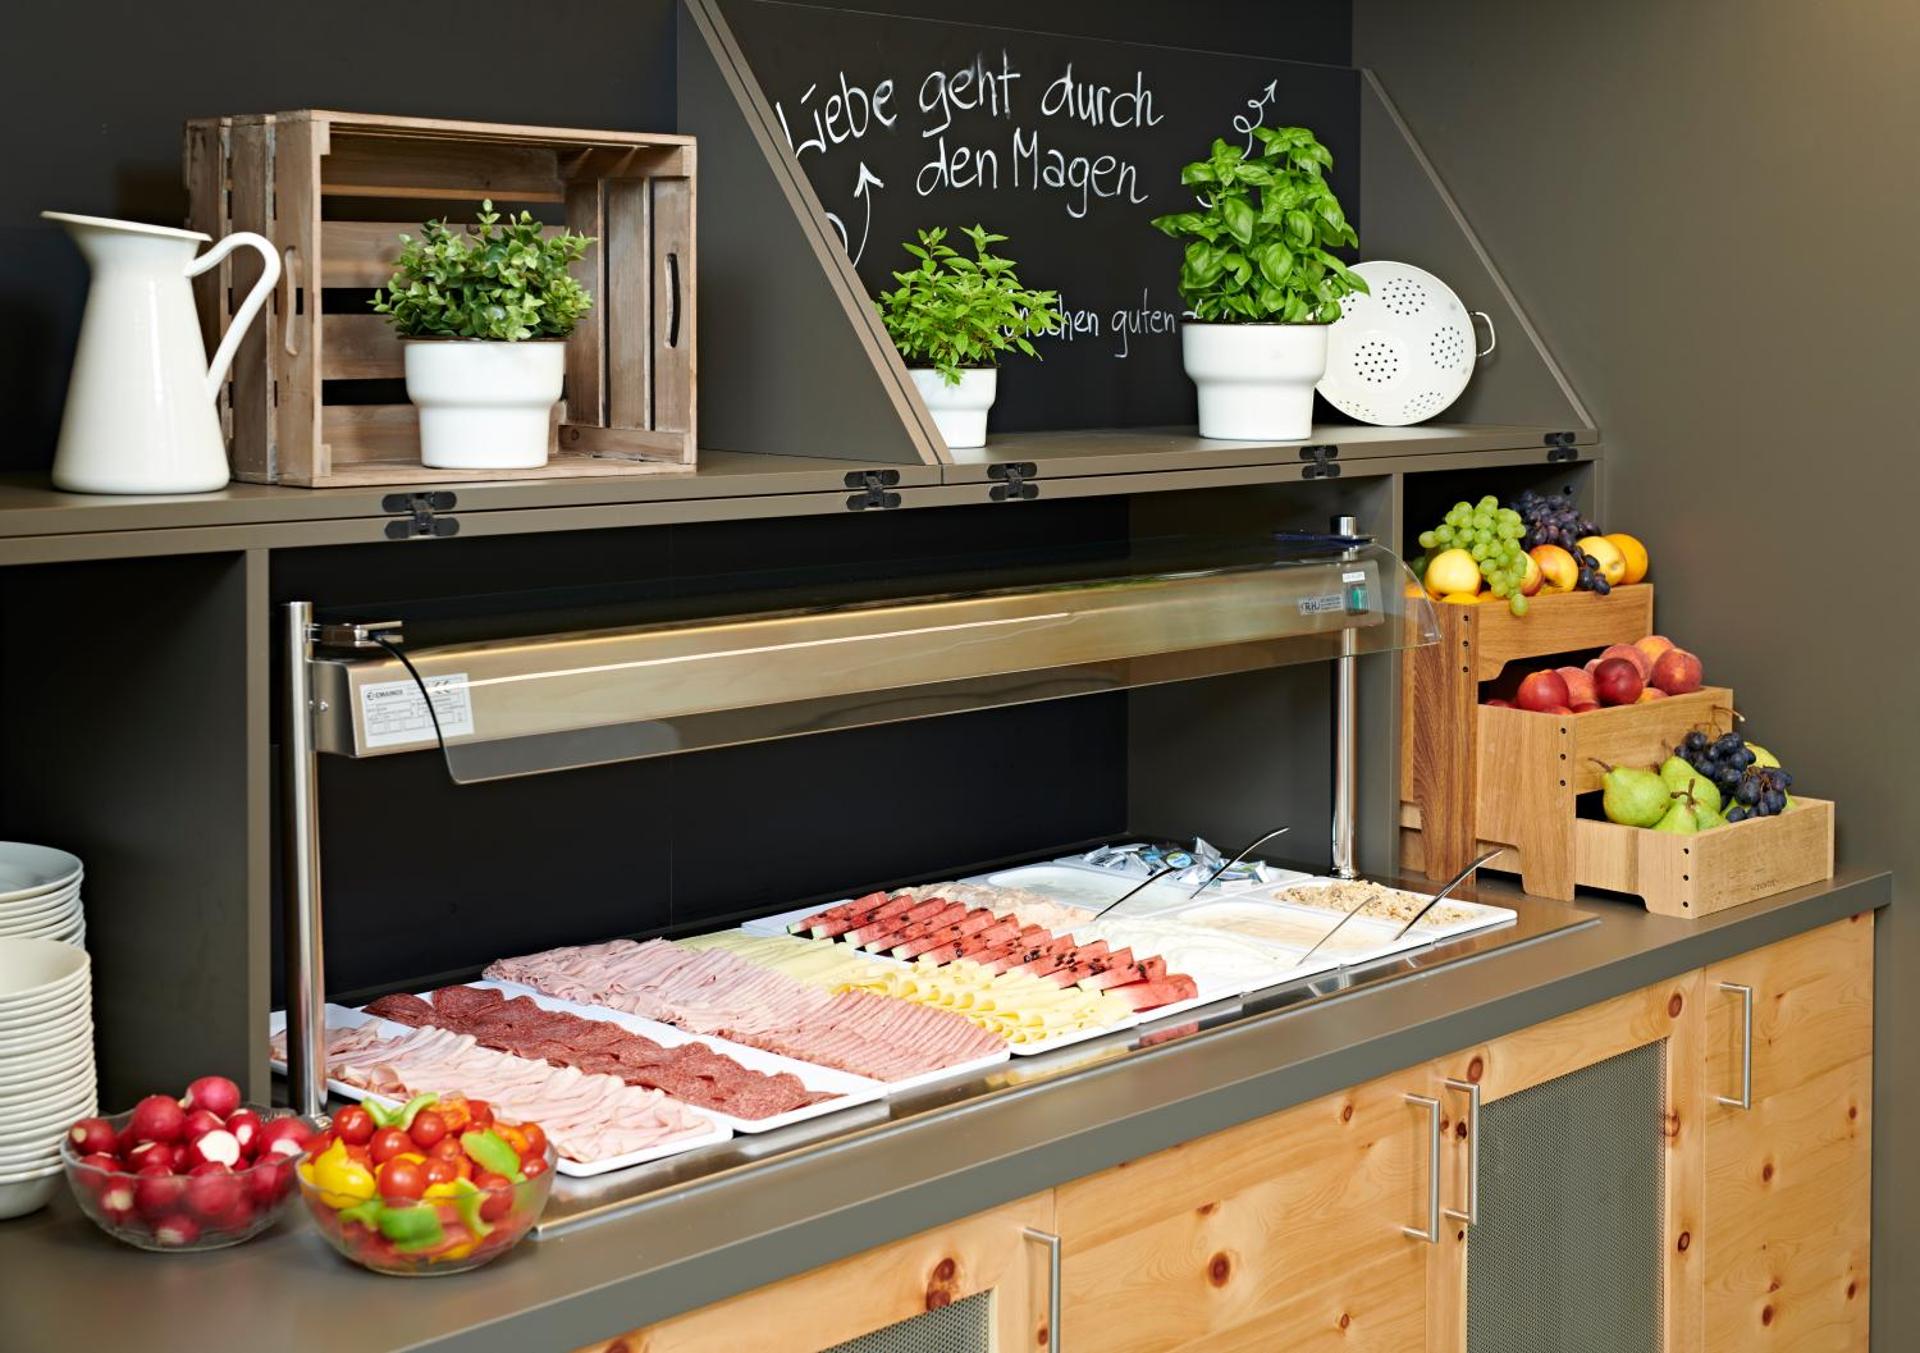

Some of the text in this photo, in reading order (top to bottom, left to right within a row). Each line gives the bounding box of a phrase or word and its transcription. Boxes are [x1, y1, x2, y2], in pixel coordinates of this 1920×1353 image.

[775, 51, 1165, 159] Liebe geht durch
[916, 127, 1149, 218] den Magen
[1111, 287, 1176, 358] guten
